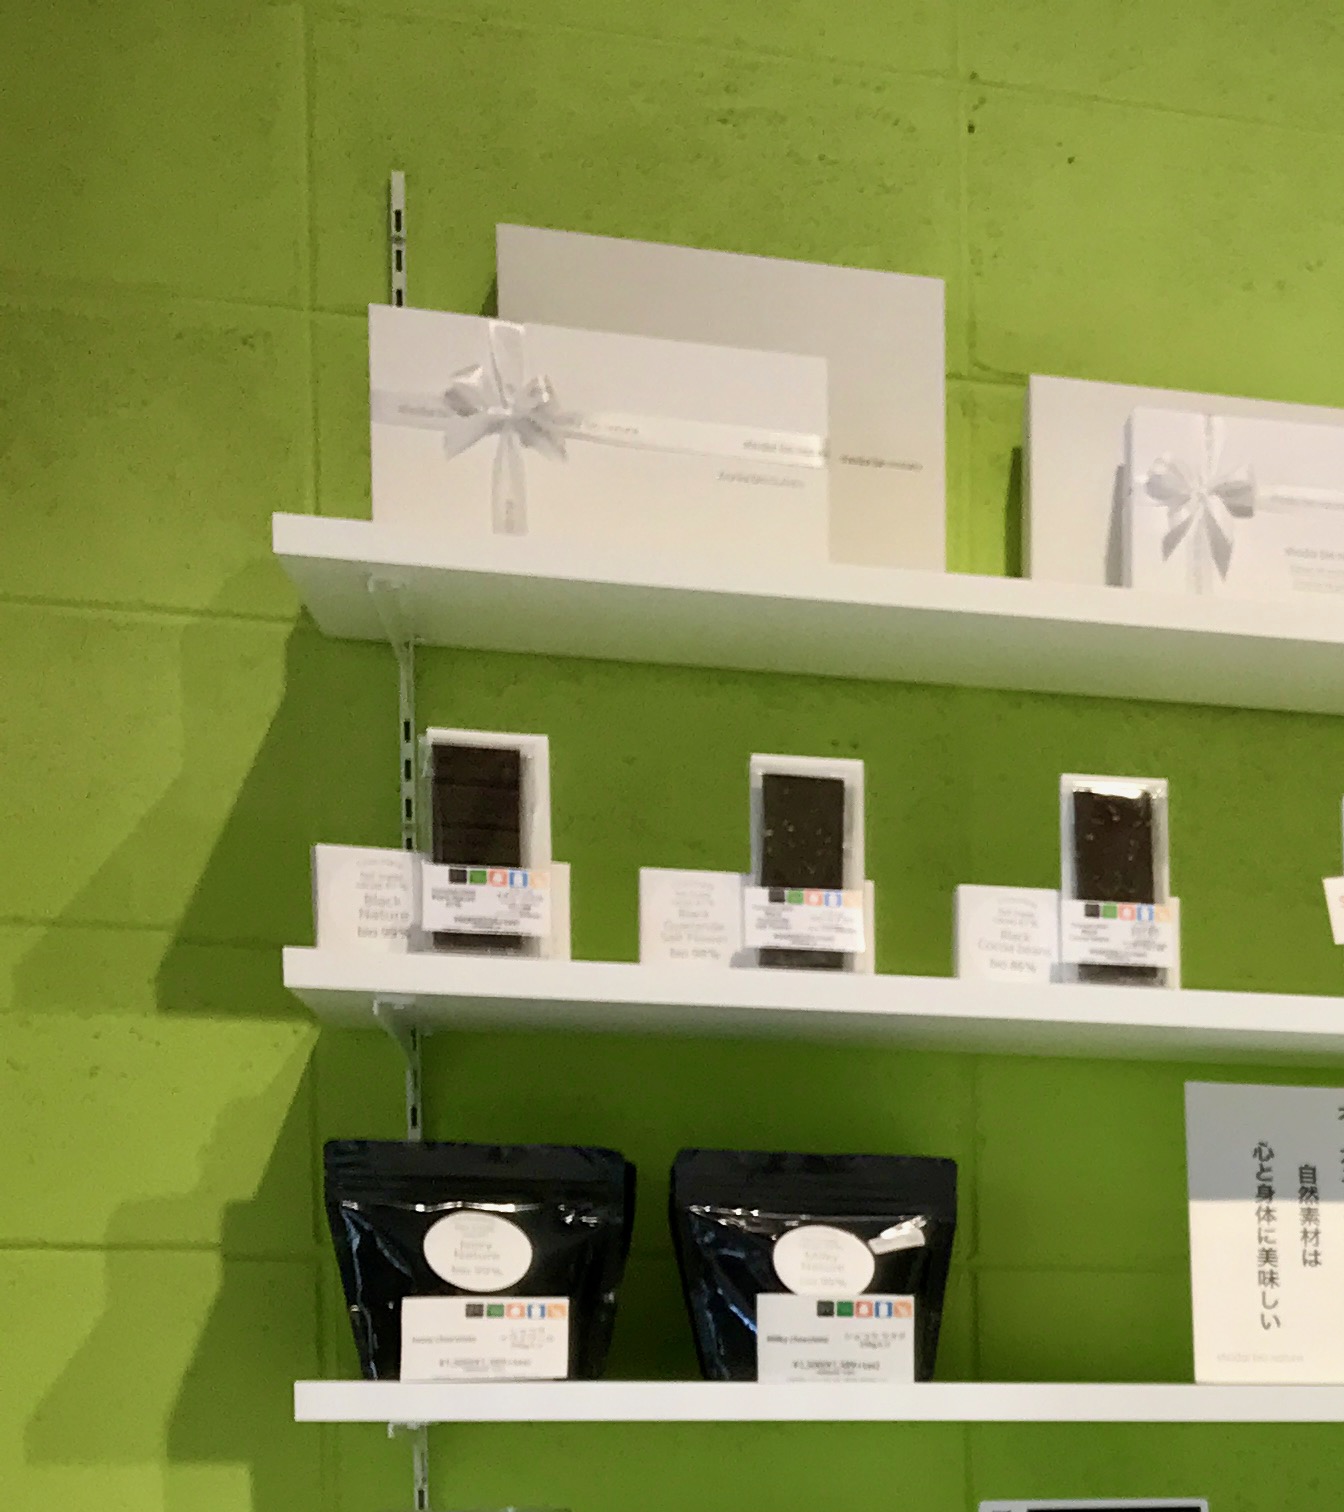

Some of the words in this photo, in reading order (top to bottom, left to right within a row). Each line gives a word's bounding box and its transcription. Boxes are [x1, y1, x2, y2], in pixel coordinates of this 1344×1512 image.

[1252, 1140, 1281, 1331] 心と身体に美味しい
[1298, 1164, 1323, 1268] 自然素材は
